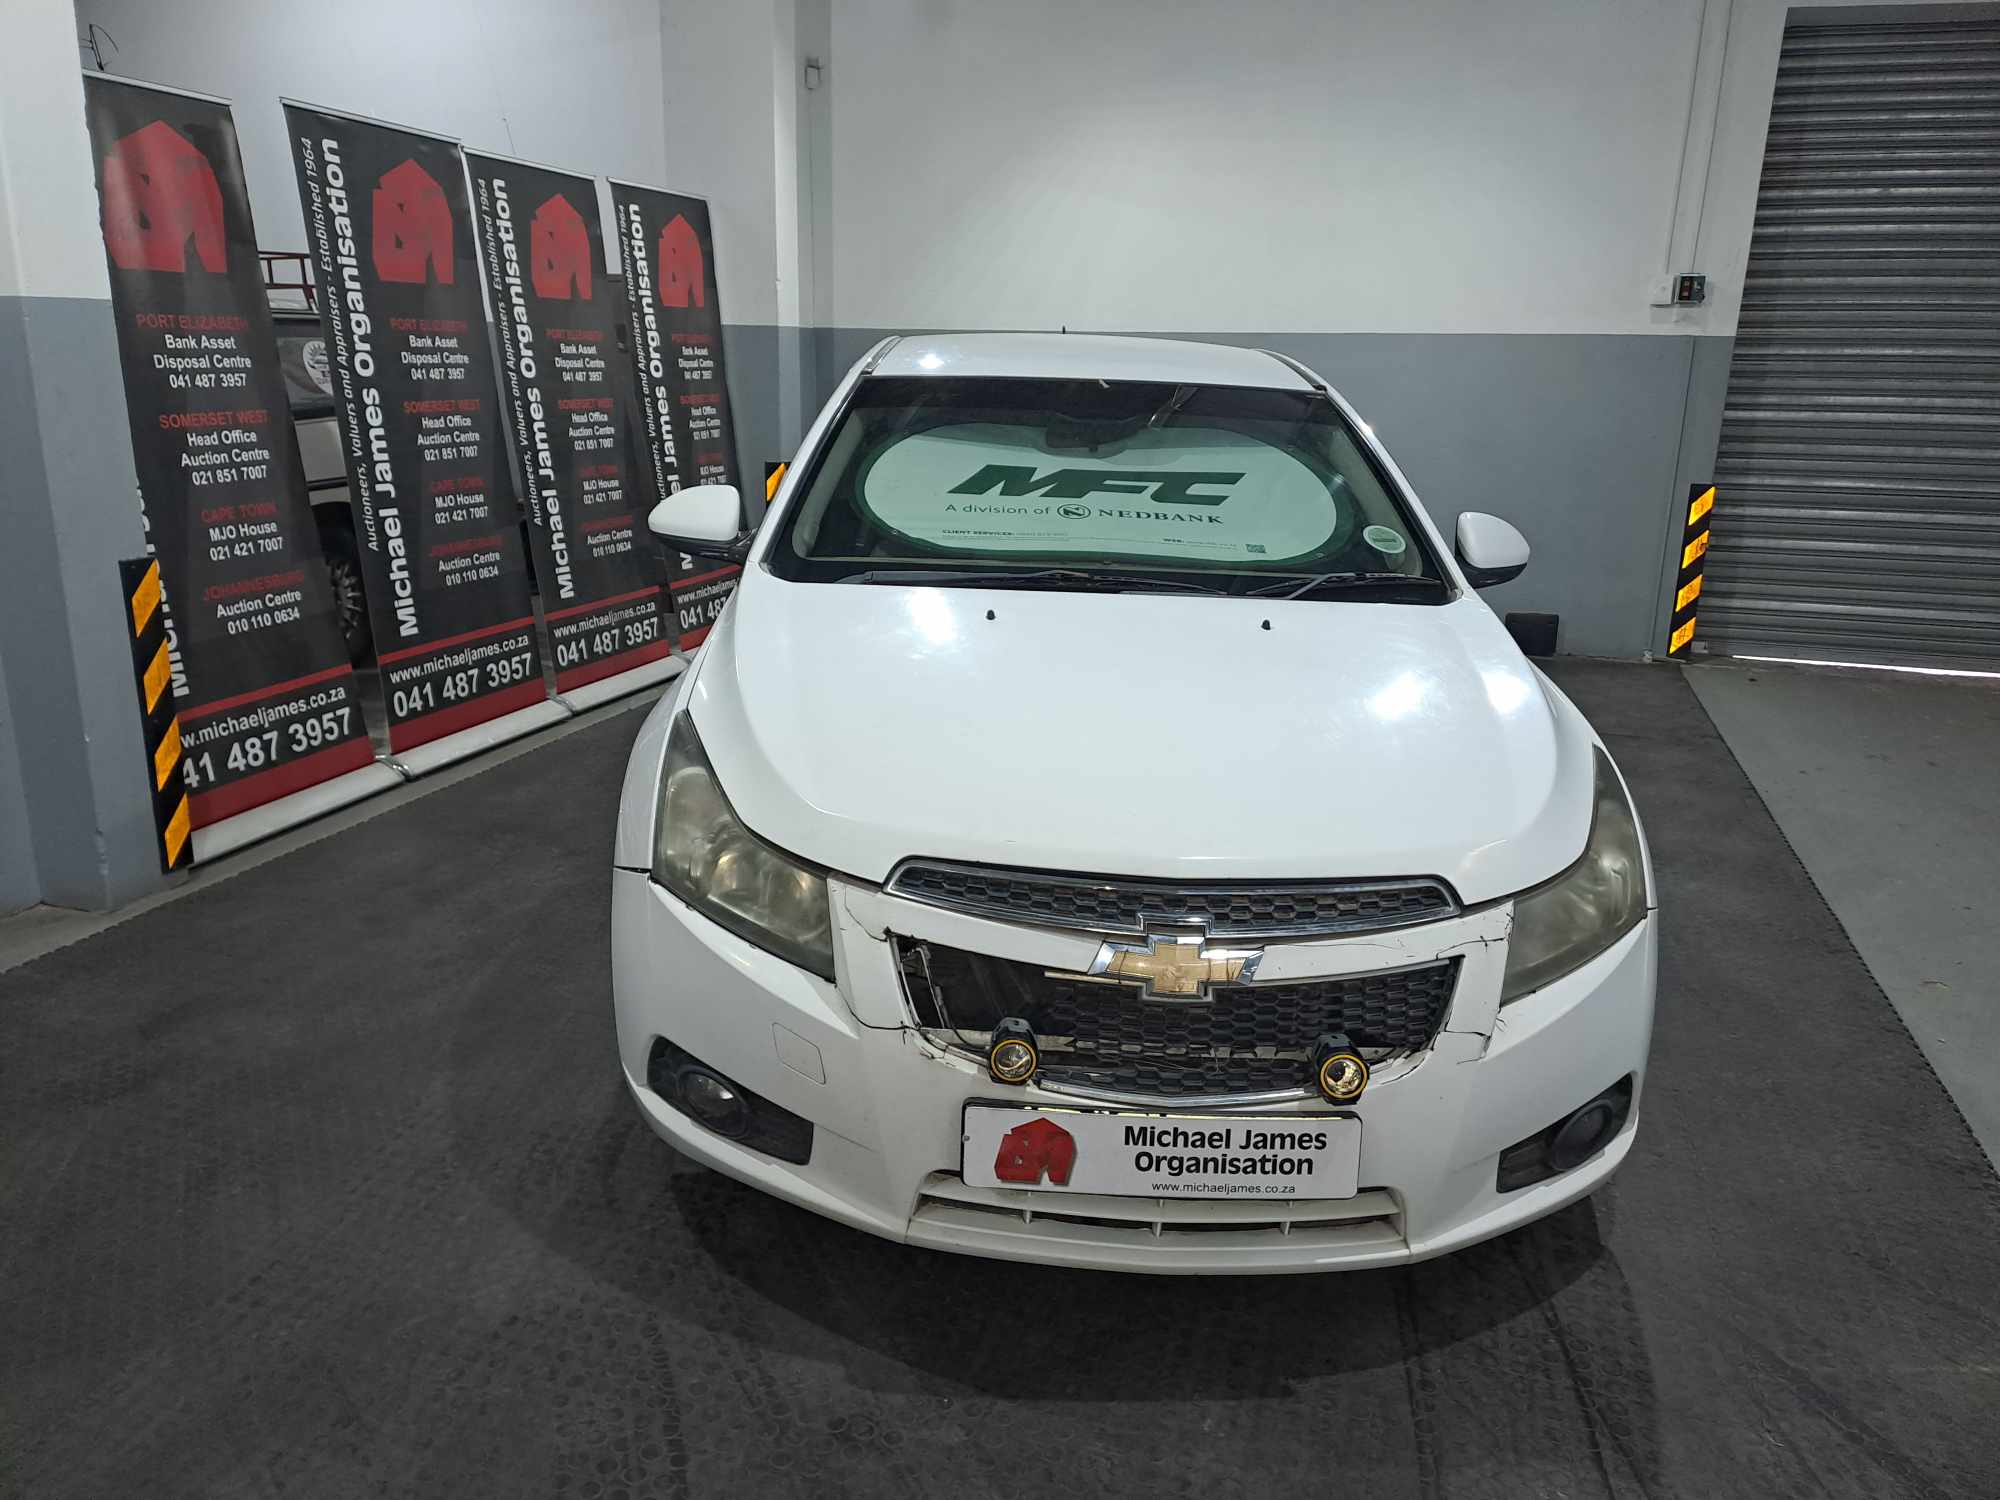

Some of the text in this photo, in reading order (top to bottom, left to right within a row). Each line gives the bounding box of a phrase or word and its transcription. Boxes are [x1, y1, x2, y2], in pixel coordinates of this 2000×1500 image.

[300, 137, 317, 177] 1964
[308, 181, 333, 272] Established
[482, 214, 503, 290] Established
[136, 313, 178, 329] PORT
[327, 285, 349, 366] Appraisers
[164, 334, 237, 349] Bank Asset
[409, 335, 458, 348] Bank Asset
[498, 301, 516, 370] Appraisers
[629, 203, 678, 468] James Organisation
[632, 311, 647, 370] Appraisers
[153, 354, 252, 372] Disposal Centre
[401, 352, 469, 366] Disposal Centre
[169, 373, 247, 389] 041 487 3957
[338, 369, 352, 398] and
[411, 368, 464, 380] 041 487 3957
[508, 371, 520, 397] and
[321, 138, 419, 637] Michael James Organisation
[493, 178, 575, 599] Michael James Organisation
[159, 409, 269, 429] SOMERSET WEST
[346, 402, 363, 457] Valuers
[422, 415, 471, 429] Head Office
[514, 400, 529, 446] Valuers
[589, 412, 608, 422] Office
[644, 397, 657, 437] Valuers
[187, 429, 257, 447] Head Office
[417, 431, 480, 446] Auction Centre
[181, 447, 270, 468] Auction Centre
[425, 446, 478, 461] 021 851 7007
[191, 465, 267, 486] 021 851 7007
[523, 451, 543, 526] Auctioneers,
[946, 464, 1247, 506] MFC
[356, 463, 379, 551] Auctioneers,
[435, 494, 484, 508] MJO House
[944, 504, 957, 512] A
[962, 503, 1028, 515] division
[1033, 506, 1050, 515] of
[1098, 508, 1225, 525] NEDBANK
[435, 506, 488, 524] 021 421 7007
[209, 521, 278, 542] MJO House
[209, 536, 283, 561] 021 421 7007
[439, 552, 500, 572] Auction Centre
[445, 566, 499, 586] 010 110 0634
[216, 590, 302, 618] Auction Centre
[680, 605, 703, 629] 041
[227, 607, 300, 635] 010 110 0634
[553, 601, 656, 638] www.michaeljames.co.za
[557, 617, 658, 667] 041 487 3957
[390, 635, 529, 684] www.michaeljames.co.za
[393, 652, 532, 717] 041 487 3957
[180, 685, 346, 748] w.michaeljames.co.za
[183, 707, 350, 788] 41 487 3957
[1124, 1126, 1328, 1150] Michael James
[1134, 1151, 1313, 1177] Organisation
[1151, 1182, 1296, 1194] www.michaeljames.co.za
